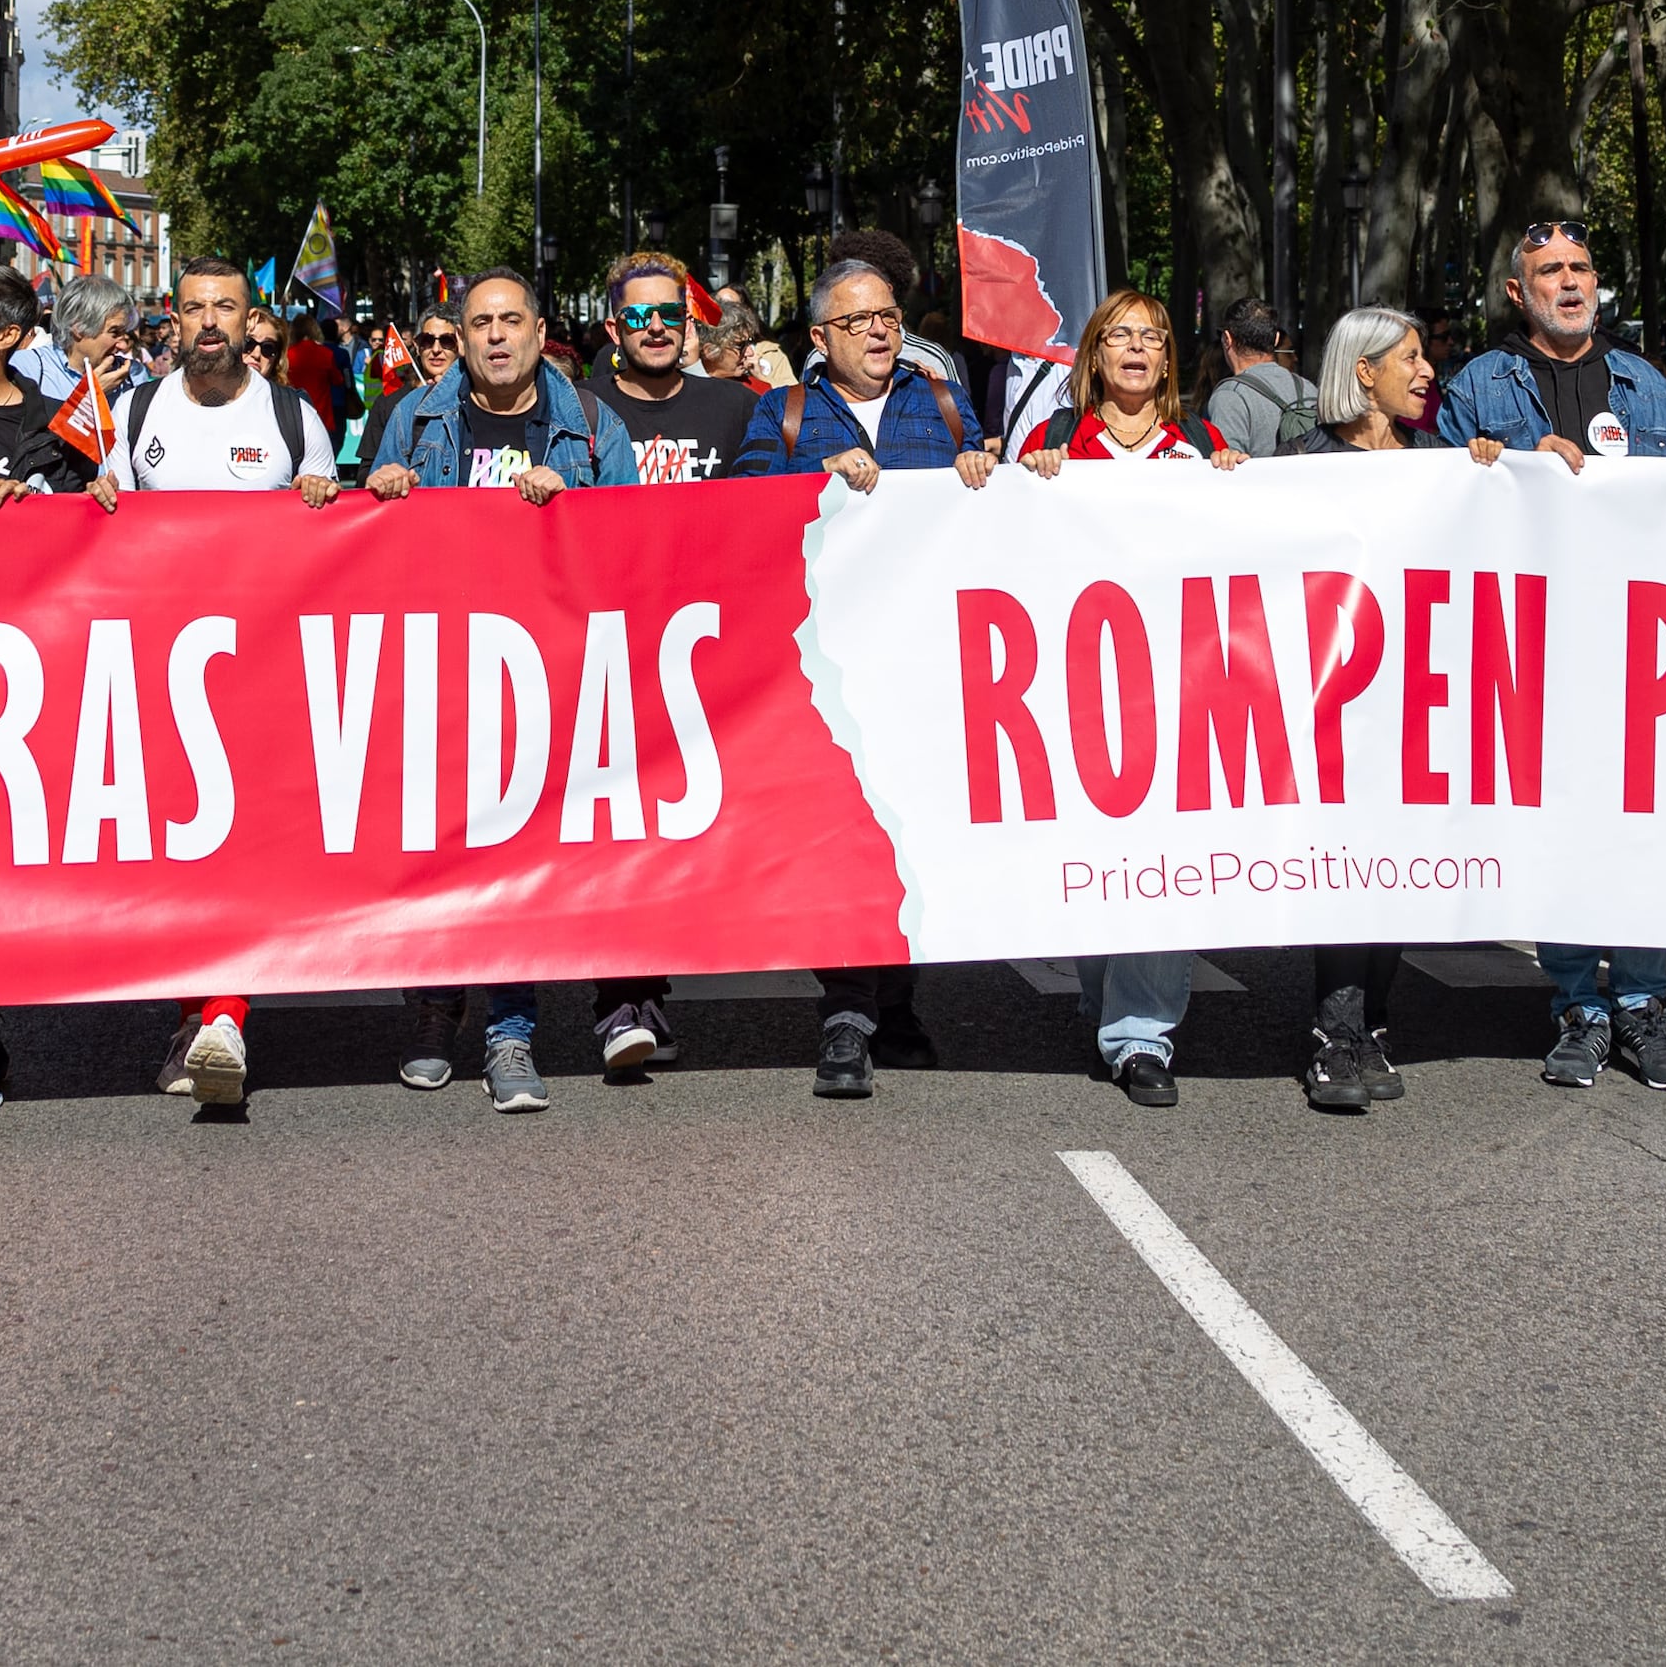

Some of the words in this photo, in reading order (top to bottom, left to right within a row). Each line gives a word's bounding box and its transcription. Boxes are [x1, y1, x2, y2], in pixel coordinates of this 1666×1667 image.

[297, 601, 725, 856] VIDAS
[955, 568, 1548, 824] ROMPEN
[1060, 848, 1504, 904] PridePositivo.com
